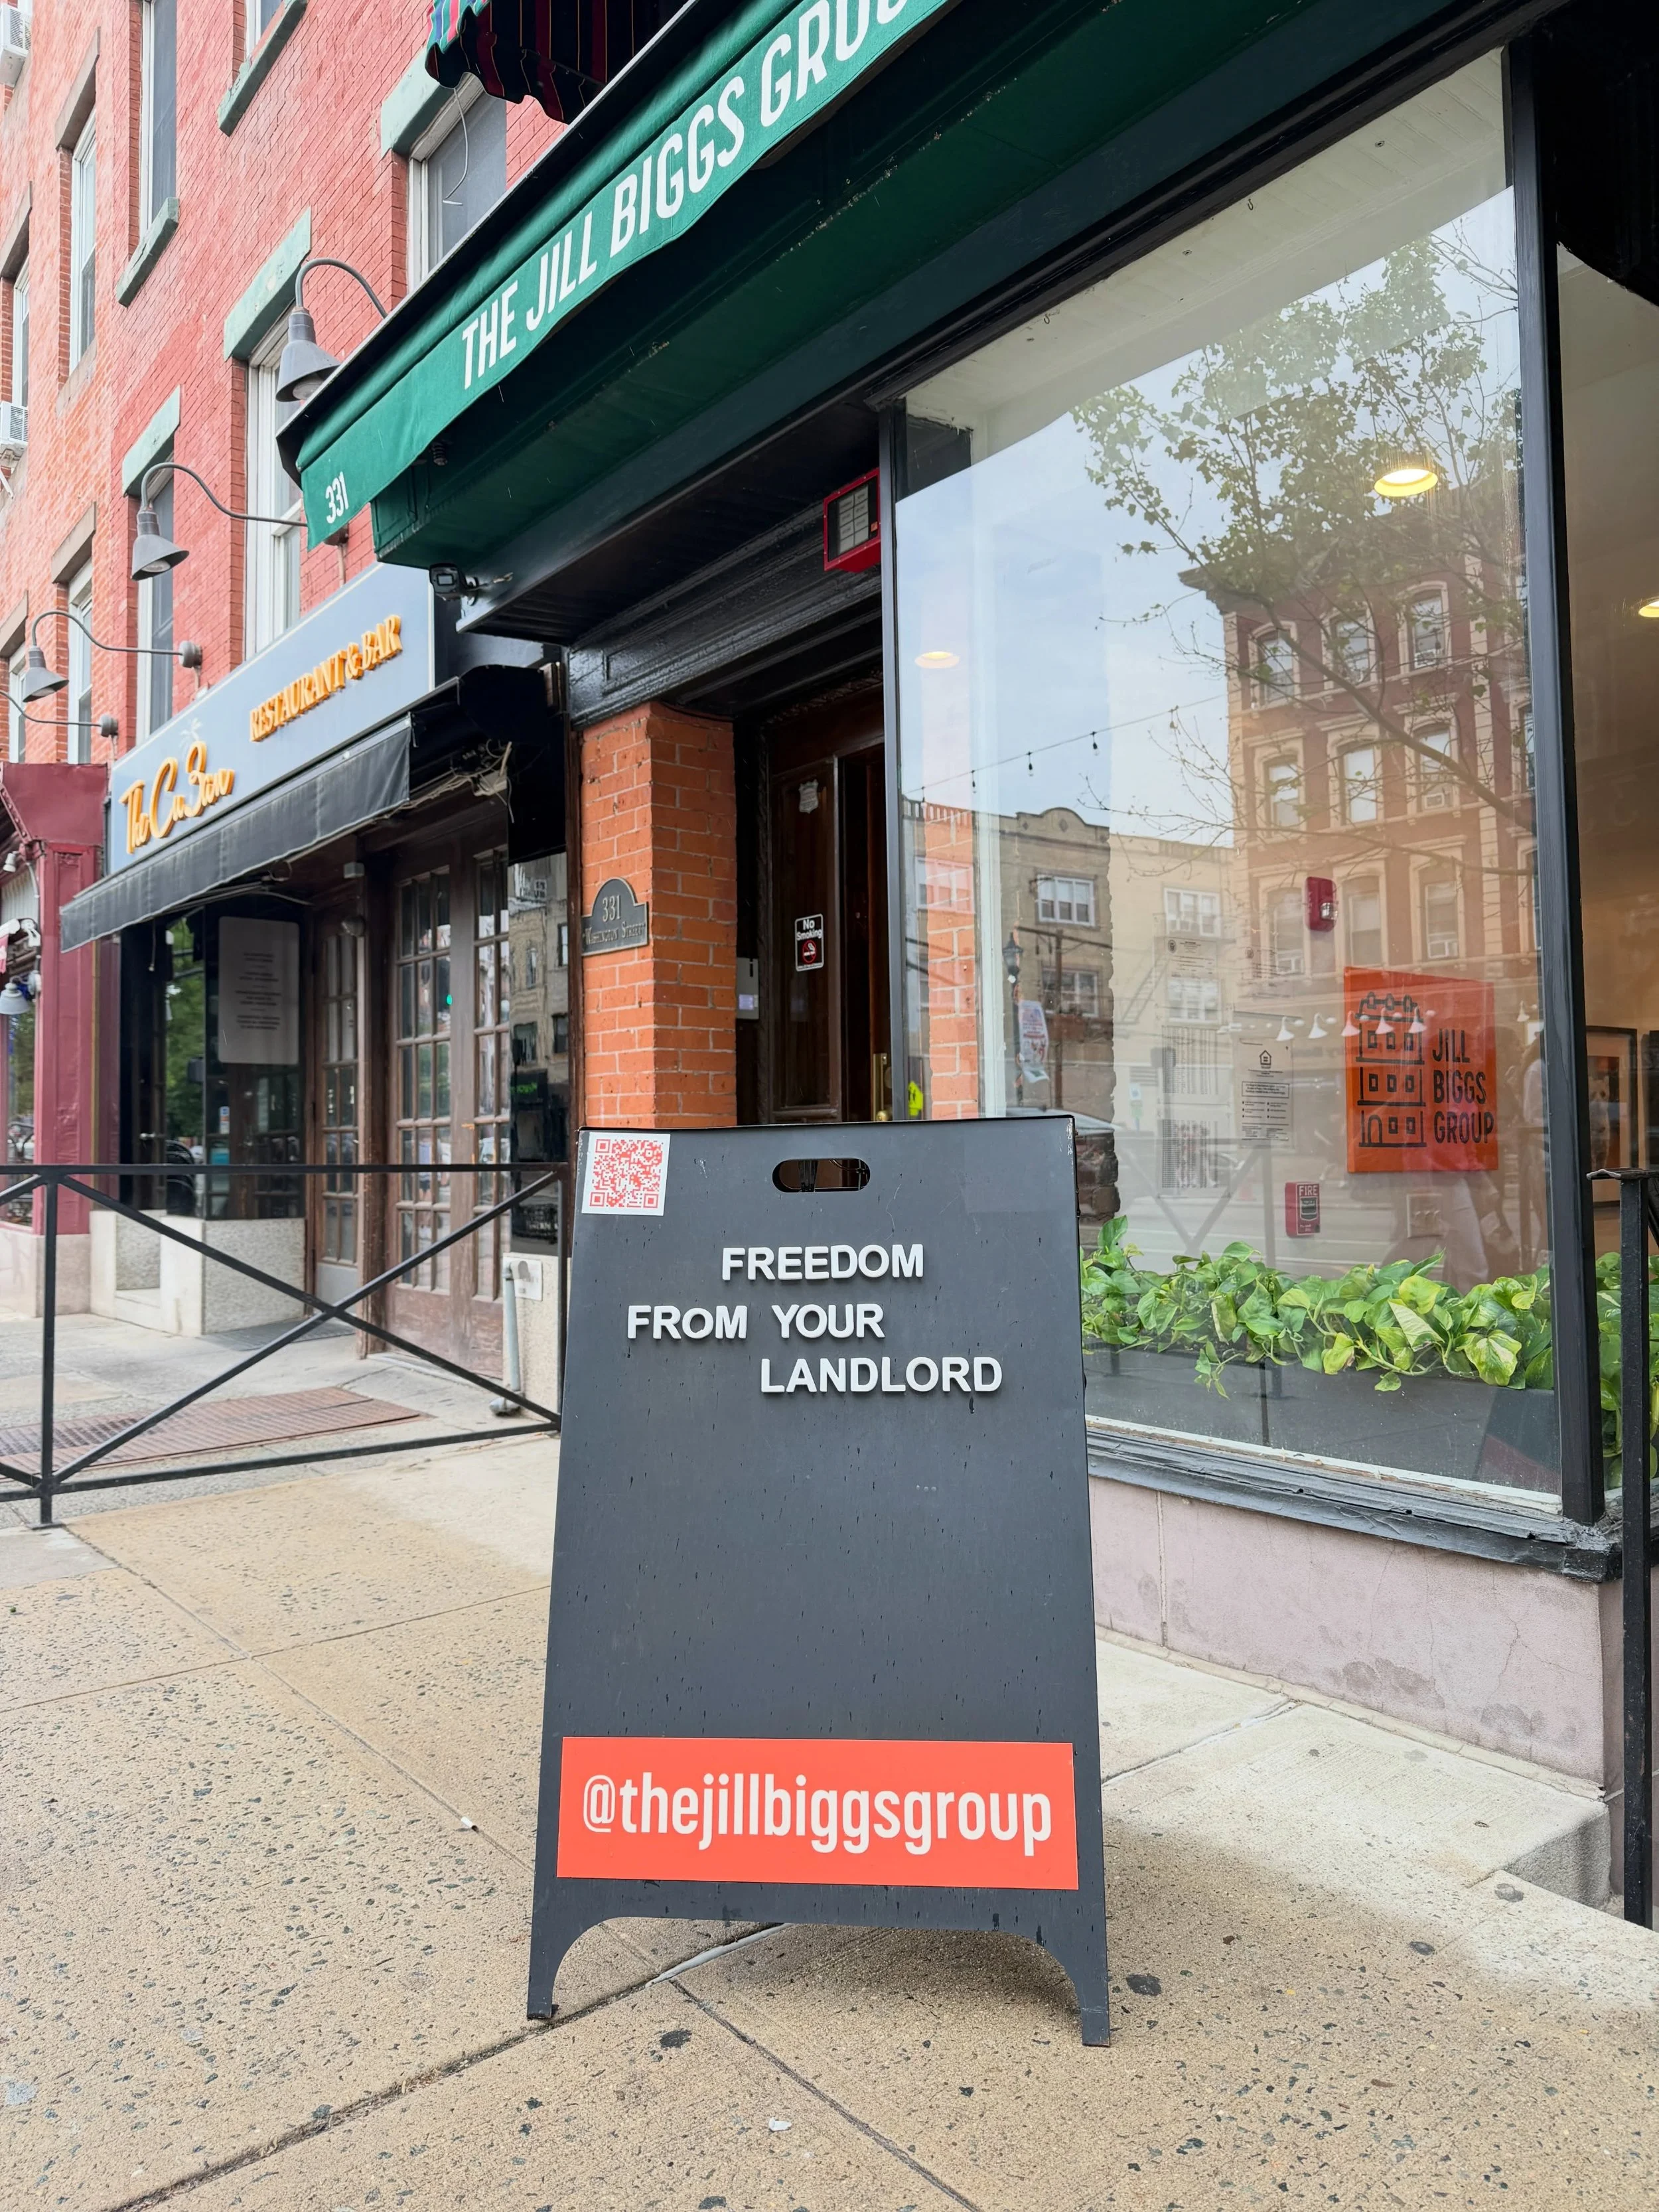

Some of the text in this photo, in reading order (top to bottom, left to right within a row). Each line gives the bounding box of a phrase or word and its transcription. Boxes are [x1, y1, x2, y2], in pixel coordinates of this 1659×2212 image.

[462, 0, 908, 390] THE JILL BIGGS GRO
[325, 471, 348, 524] 331
[250, 650, 346, 742] RESTAURANT
[362, 615, 403, 670] BAR
[119, 779, 151, 854] The
[603, 894, 620, 922] 331
[803, 919, 815, 930] No
[796, 930, 823, 941] Smoking
[1432, 1029, 1471, 1063] JILL
[1433, 1070, 1487, 1105] BIGGS
[1433, 1110, 1494, 1144] GROUP
[1299, 1185, 1318, 1196] FIRE
[722, 1244, 924, 1281] FREEDOM
[627, 1303, 885, 1339] FROM YOUR
[760, 1357, 1003, 1392] LANDLORD
[583, 1771, 1052, 1857] @thejillbiggsgroup
